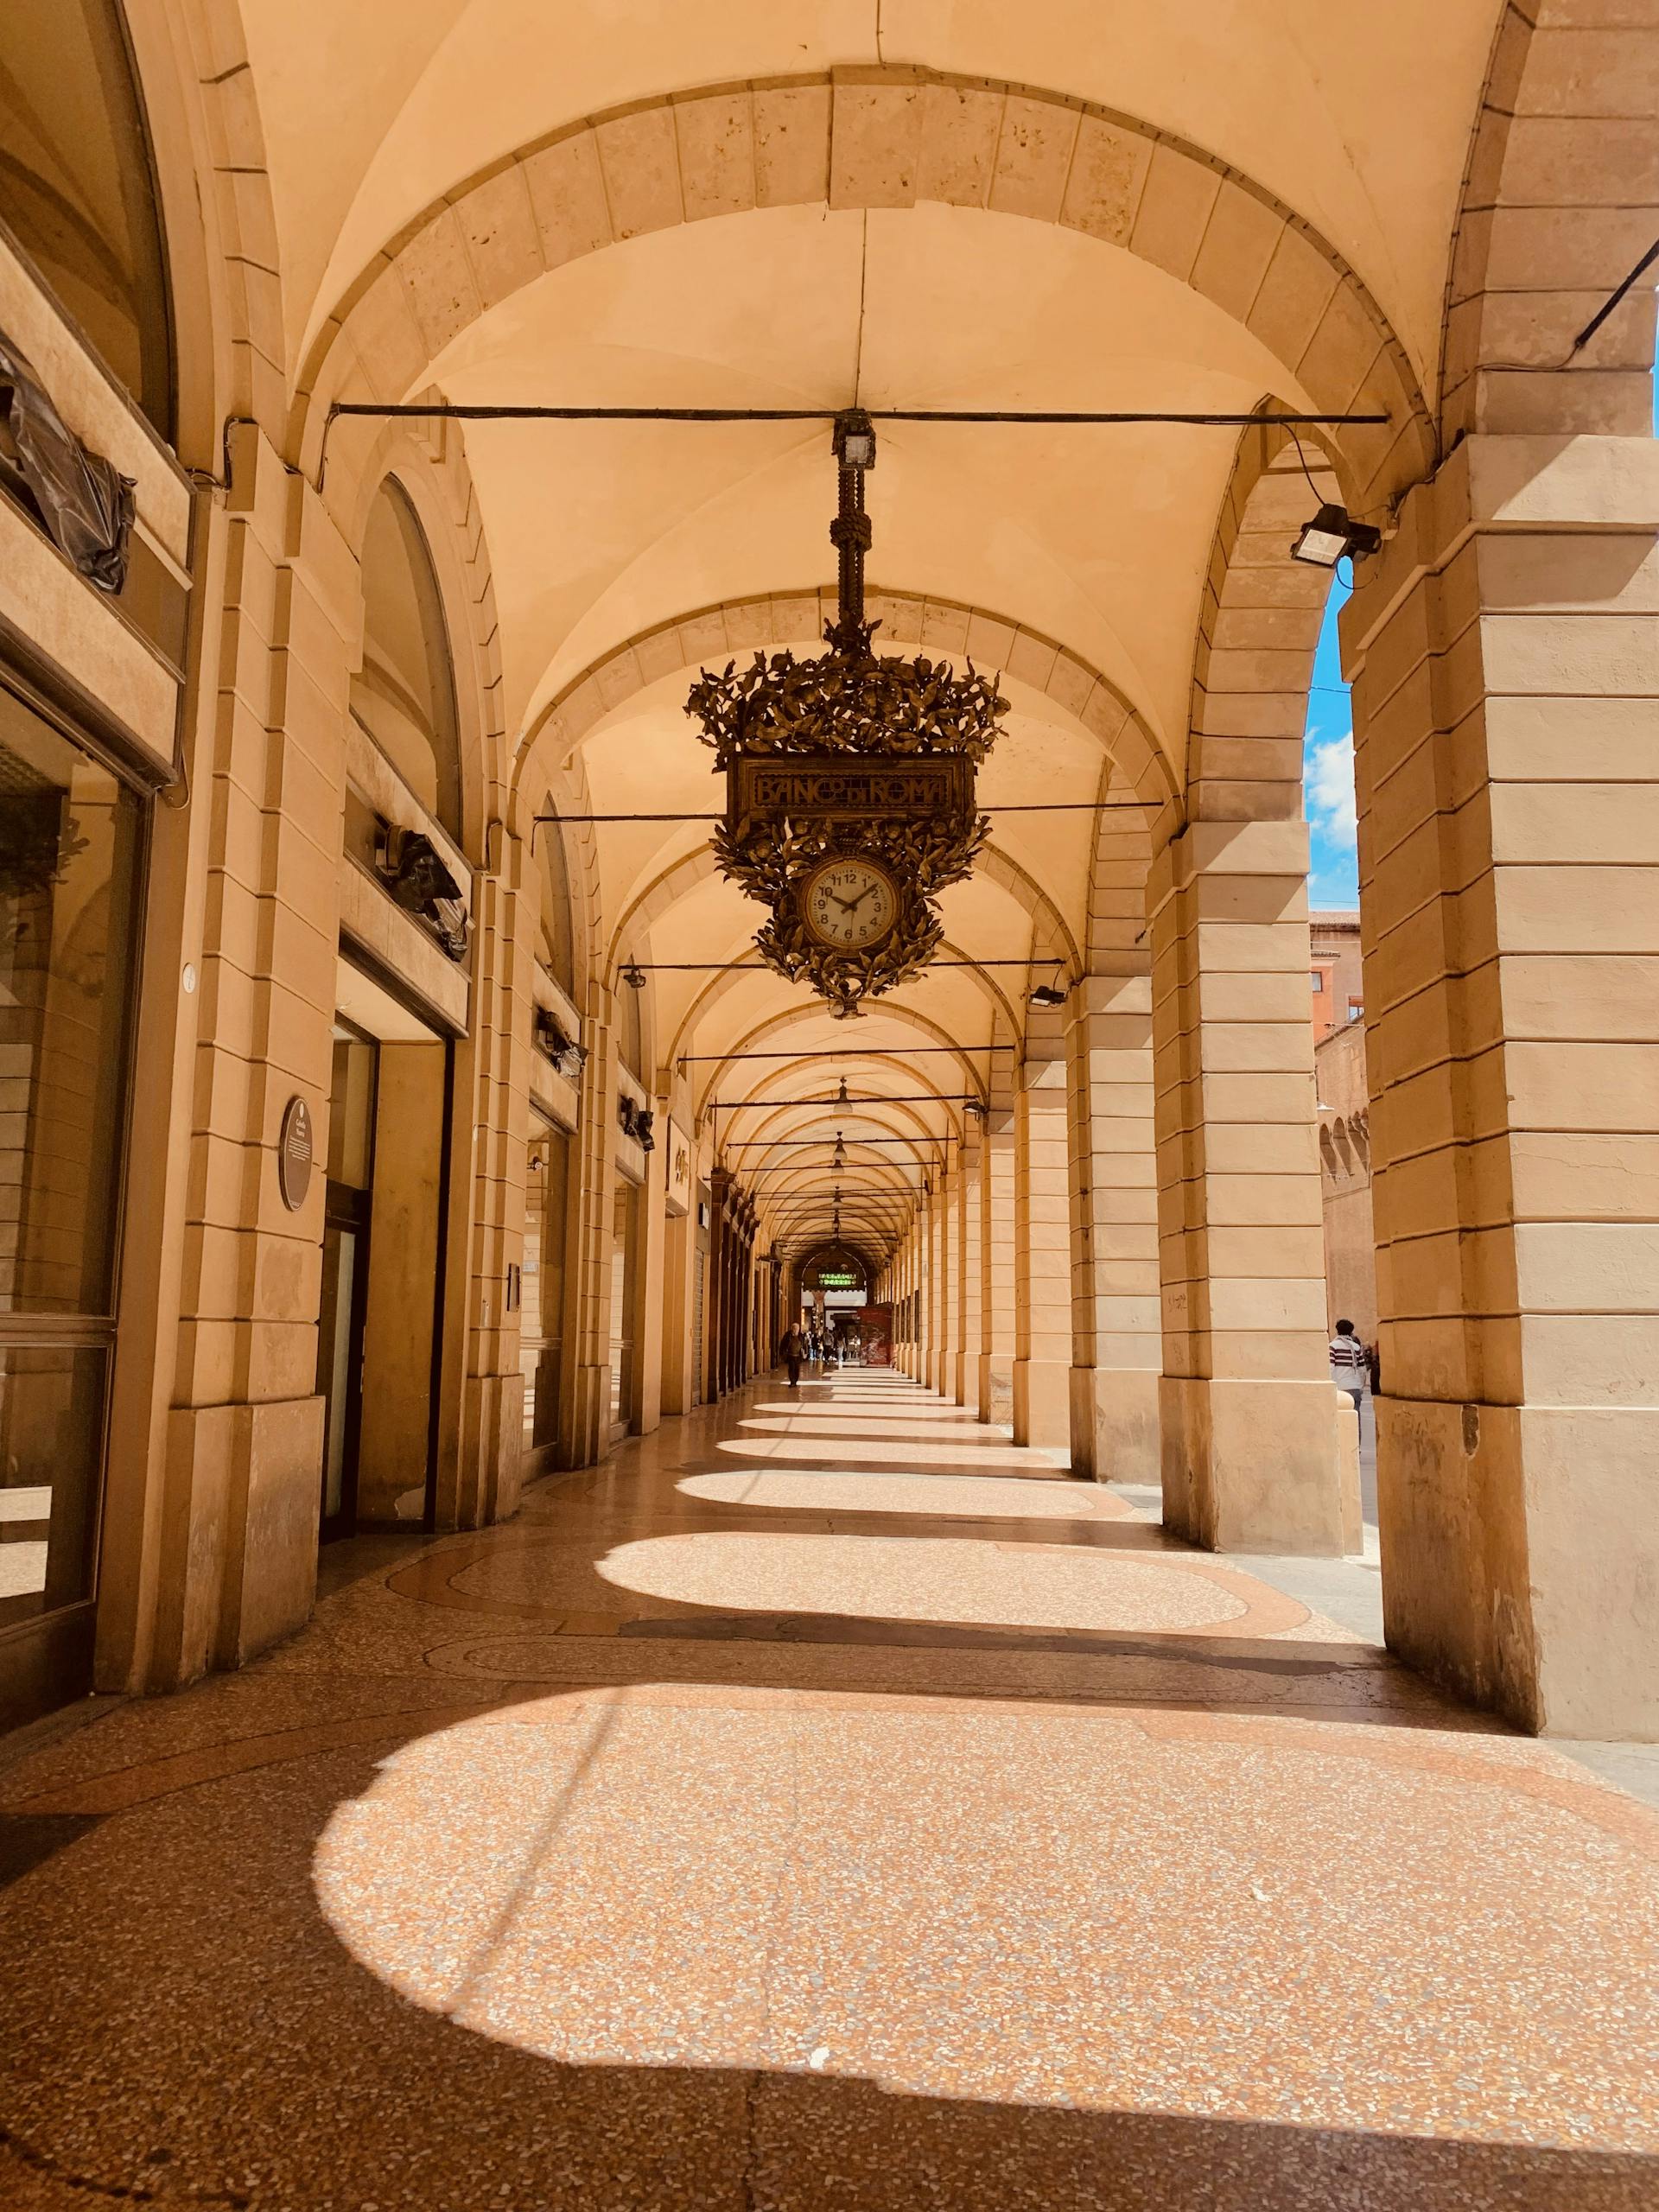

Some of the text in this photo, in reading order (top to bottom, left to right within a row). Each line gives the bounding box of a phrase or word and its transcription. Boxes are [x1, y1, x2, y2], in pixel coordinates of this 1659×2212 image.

[758, 778, 944, 803] BANCO DI ROMA
[831, 875, 842, 886] 11
[844, 874, 856, 884] 12
[862, 878, 867, 887] 1
[819, 887, 833, 897] 10
[871, 888, 879, 899] 2
[817, 899, 826, 910] 9
[874, 902, 881, 912] 3
[820, 914, 829, 925] 8
[869, 917, 878, 926] 4
[830, 924, 838, 934] 7
[844, 929, 853, 939] 6
[859, 925, 868, 936] 5
